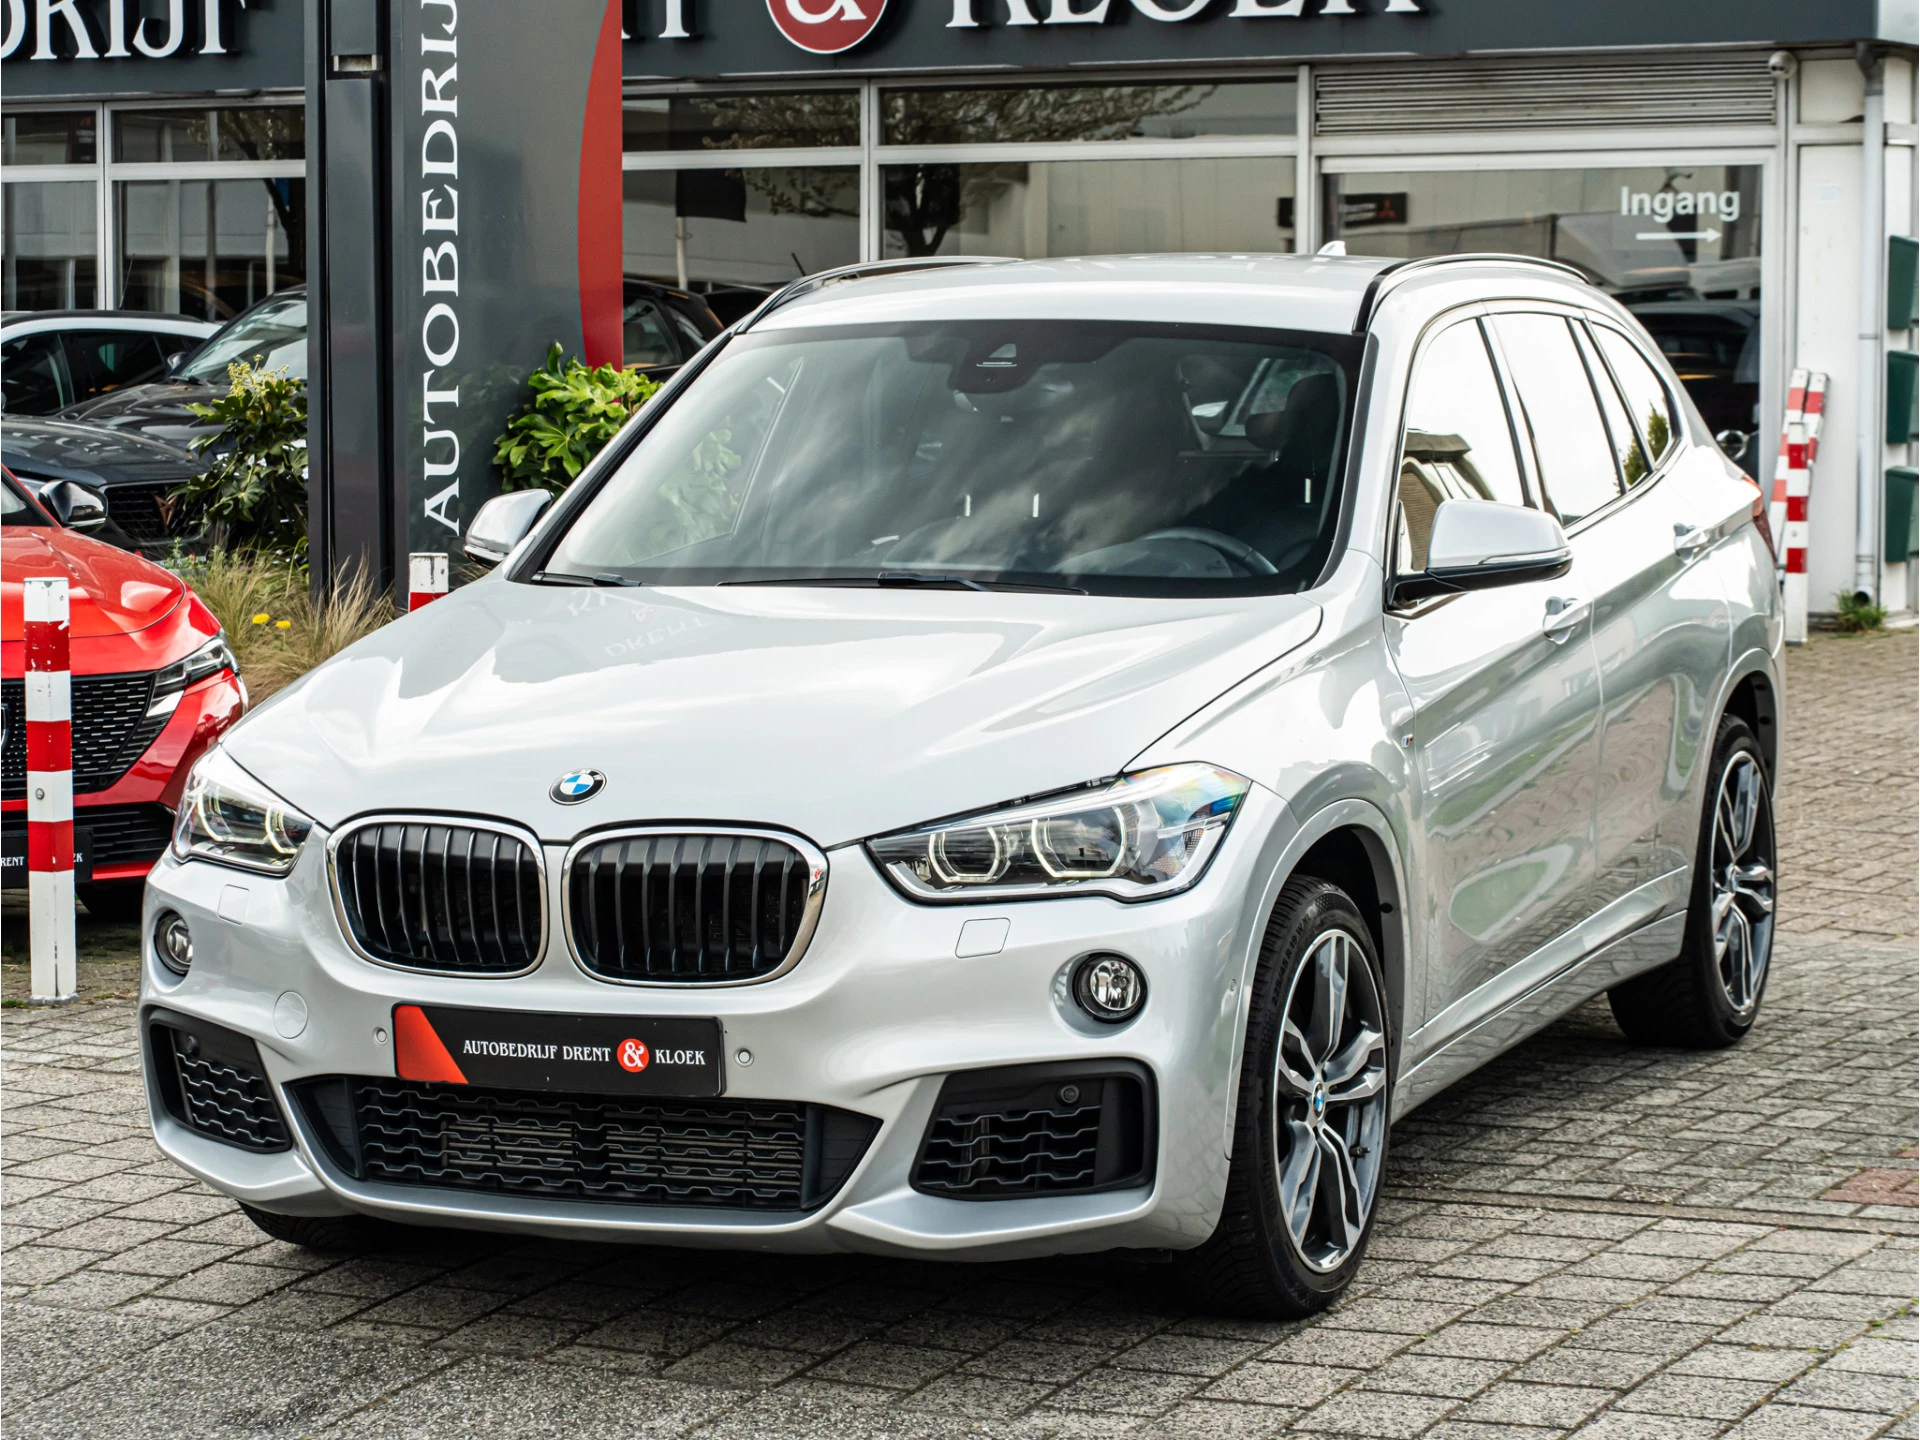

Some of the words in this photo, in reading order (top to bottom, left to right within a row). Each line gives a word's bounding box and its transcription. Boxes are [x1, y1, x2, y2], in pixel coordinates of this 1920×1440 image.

[1620, 186, 1740, 223] Ingang
[462, 1038, 559, 1060] AUTOBEDRIJF
[562, 1045, 611, 1062] DRENT
[622, 1041, 646, 1068] &
[655, 1049, 706, 1065] KLOEK
